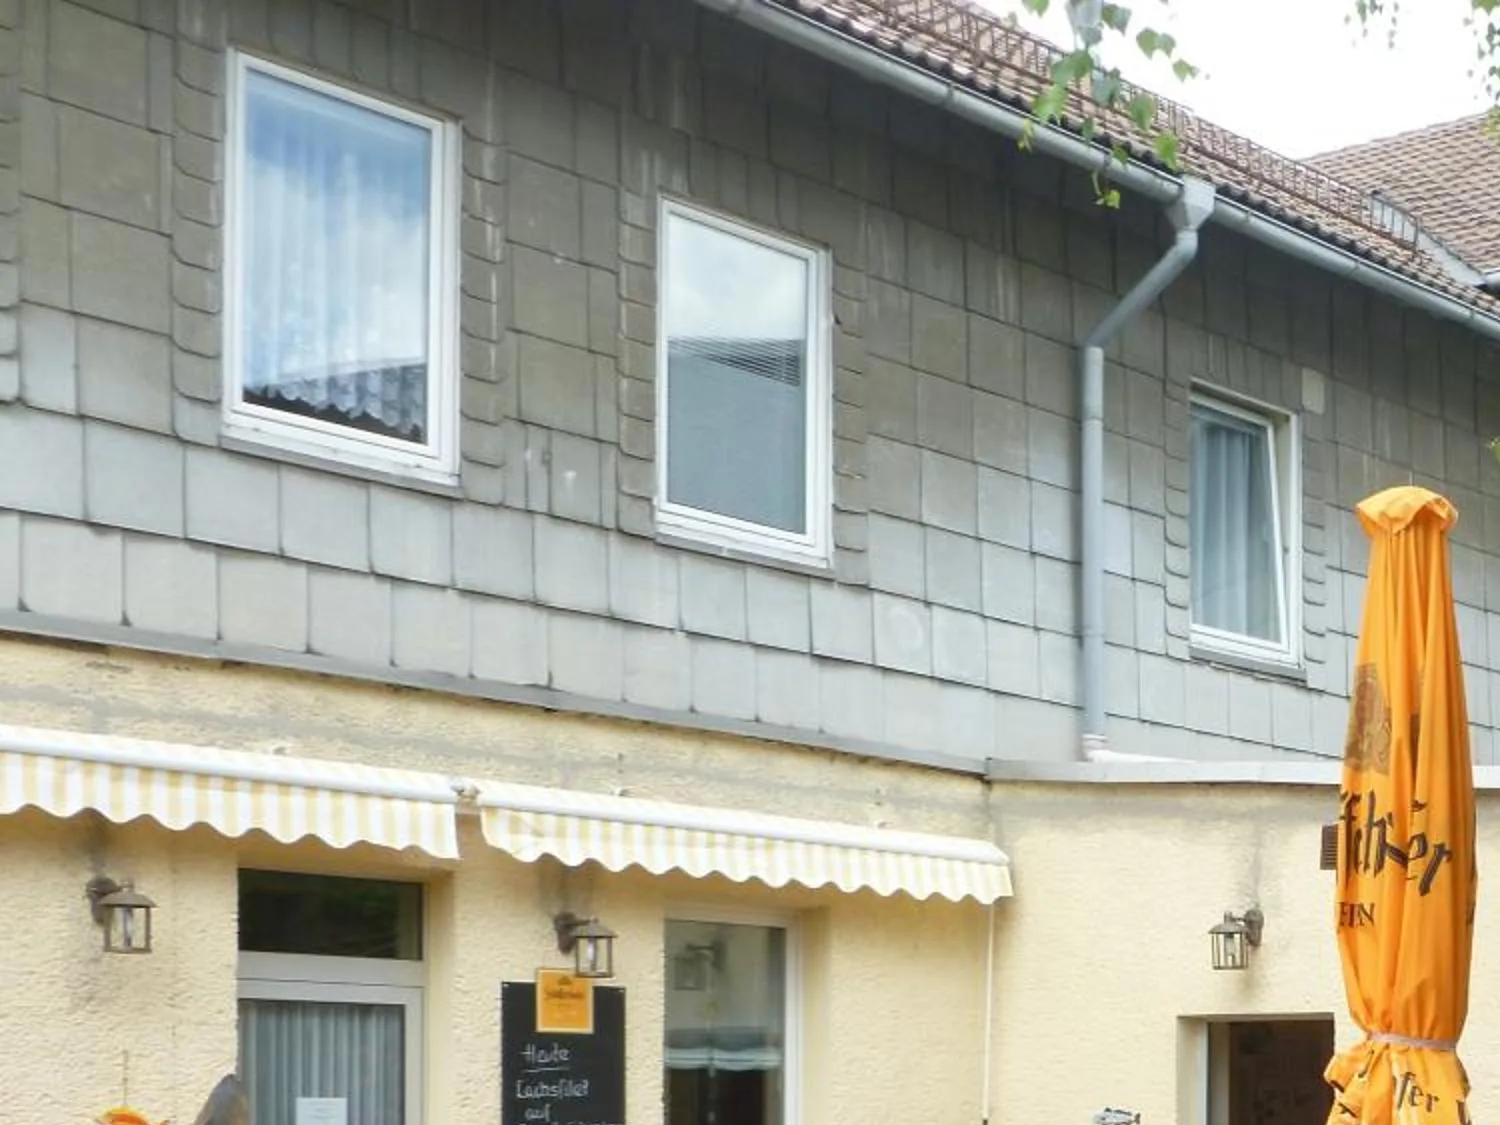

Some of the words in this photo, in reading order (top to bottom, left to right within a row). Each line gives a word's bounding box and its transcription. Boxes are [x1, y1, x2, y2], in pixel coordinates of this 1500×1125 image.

[520, 1043, 570, 1063] Heute
[516, 1079, 589, 1099] Lachsfilet
[525, 1103, 550, 1121] auf
